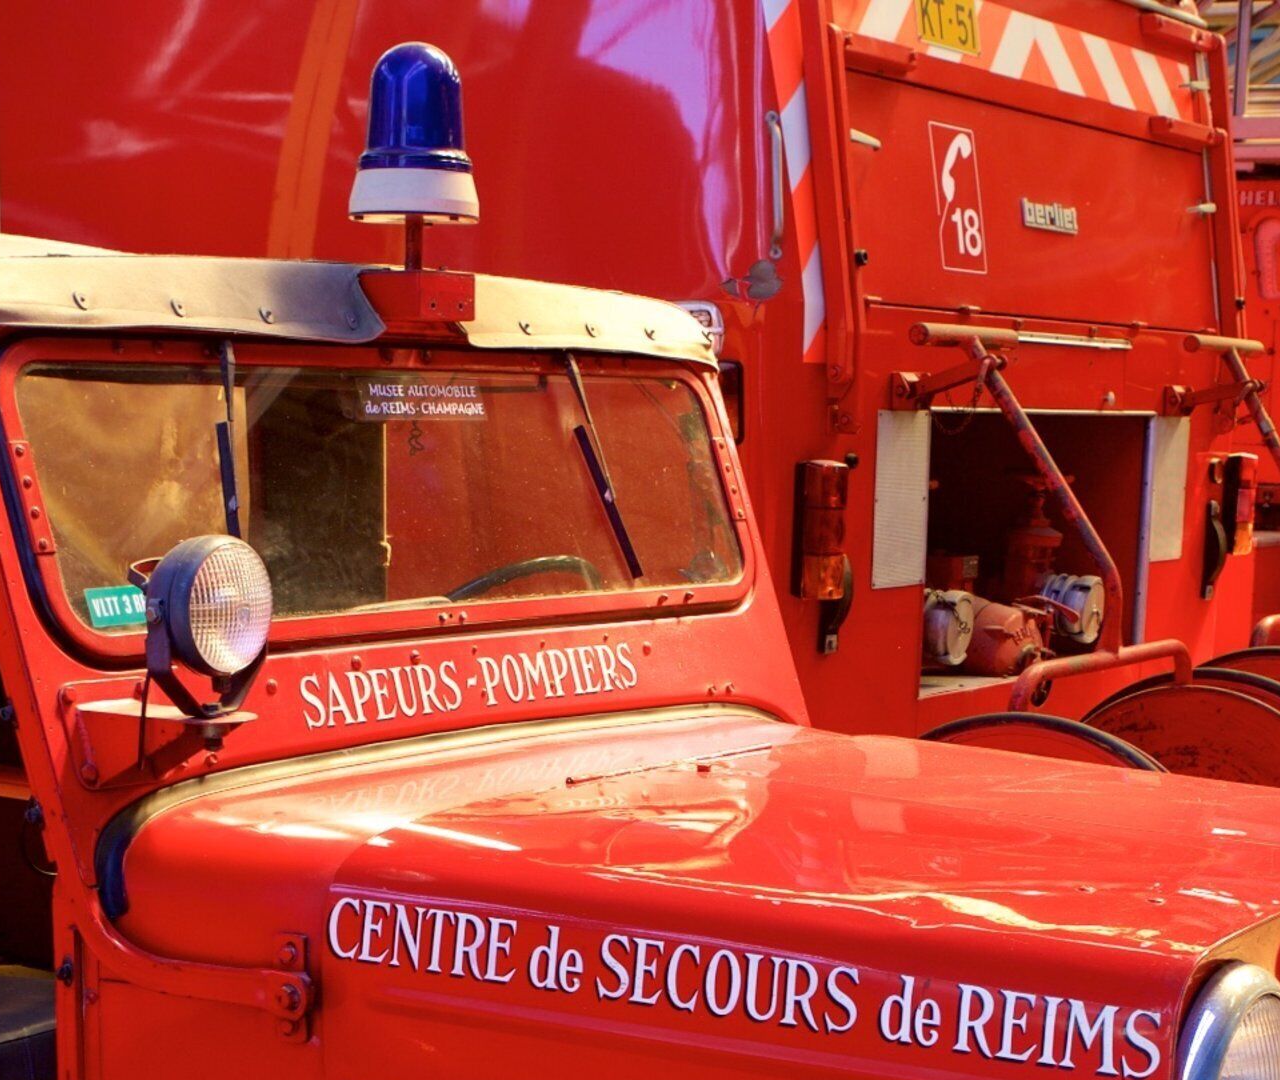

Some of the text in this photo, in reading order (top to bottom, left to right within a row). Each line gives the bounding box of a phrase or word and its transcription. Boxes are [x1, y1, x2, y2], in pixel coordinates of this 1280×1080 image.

[1022, 198, 1079, 232] berliet
[951, 208, 982, 256] 18
[368, 383, 477, 398] MUSEE AUTOMOBILE
[365, 401, 380, 414] de
[91, 596, 120, 618] VLTT
[122, 594, 133, 614] 3
[329, 897, 1161, 1079] CENTRE de SECOURS de REIMS
